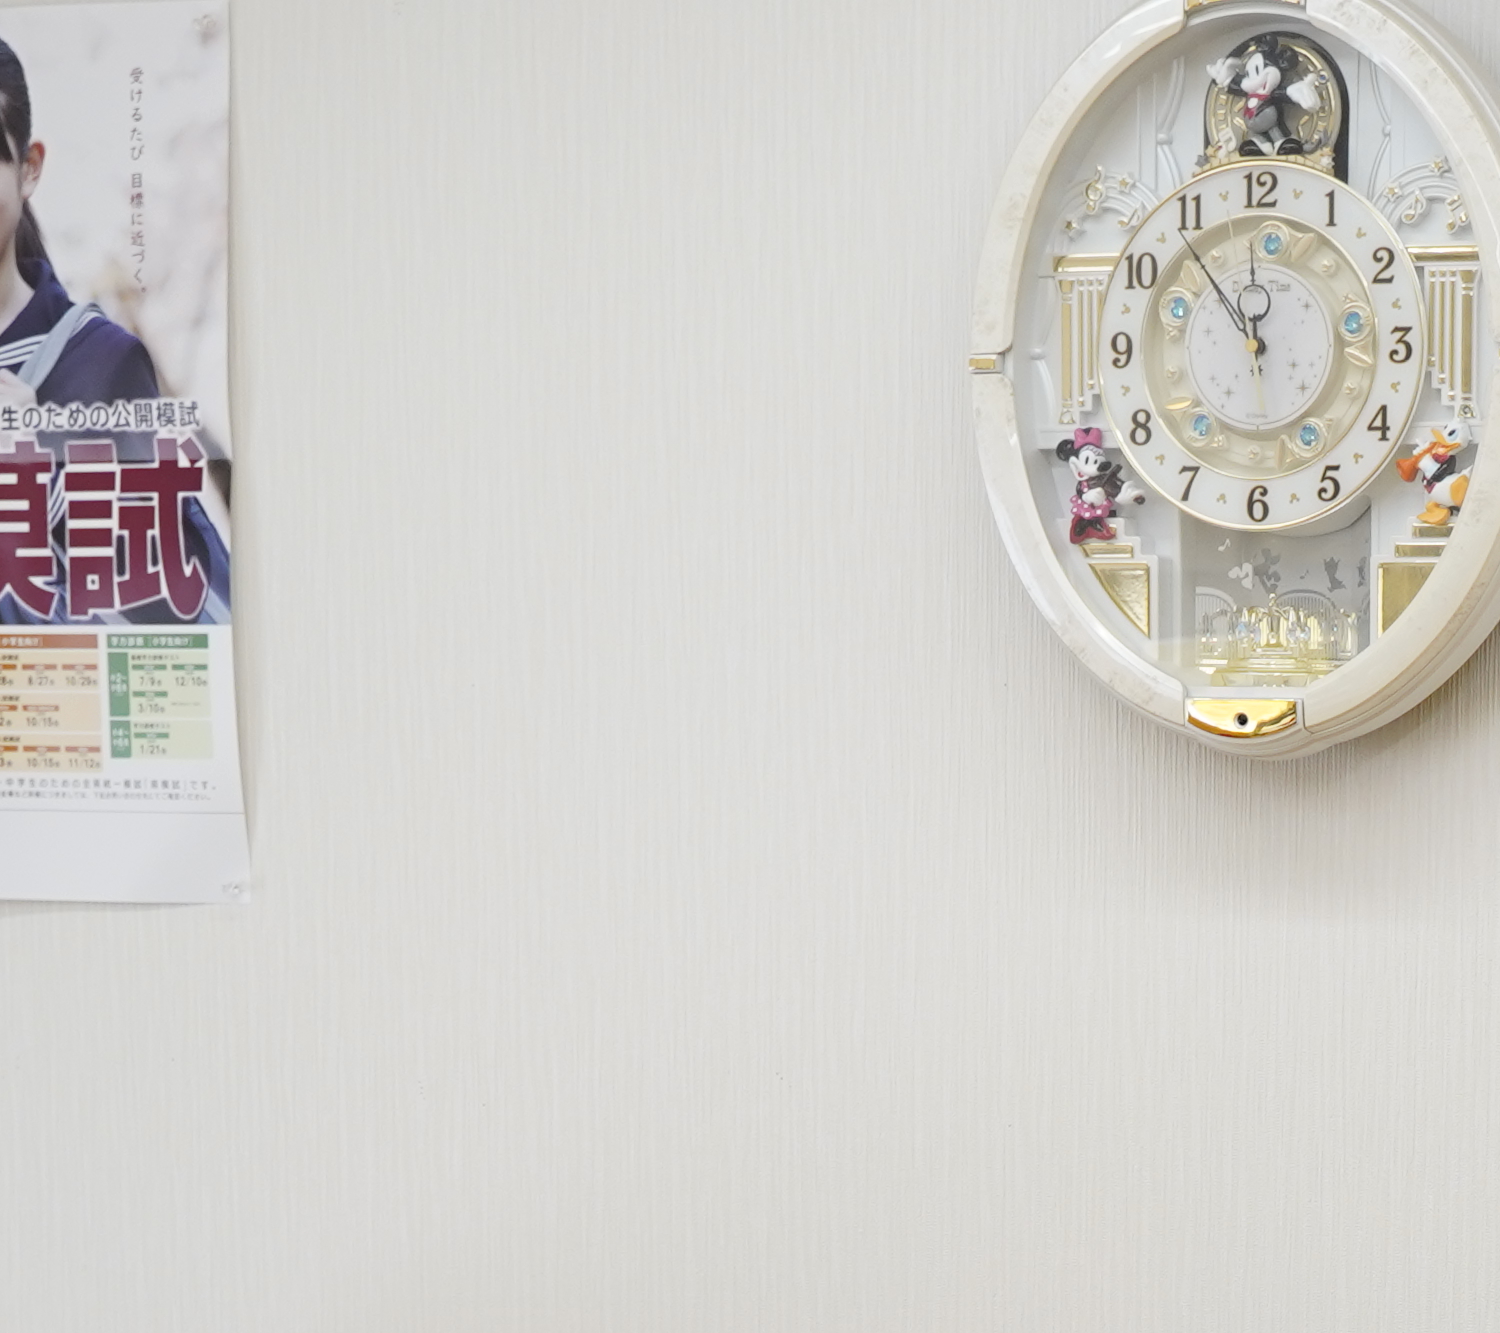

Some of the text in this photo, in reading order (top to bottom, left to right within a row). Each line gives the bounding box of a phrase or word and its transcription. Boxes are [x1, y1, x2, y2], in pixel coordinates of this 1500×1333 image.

[130, 67, 147, 294] 受けるたび 目標に近づく。
[1243, 172, 1278, 208] 12
[1177, 193, 1203, 230] 11
[1325, 190, 1337, 227] 1
[1125, 253, 1158, 289] 10
[1372, 248, 1395, 284] 2
[1111, 333, 1133, 368] 9
[1389, 326, 1412, 363] 3
[1130, 409, 1152, 446] 8
[1368, 405, 1390, 441] 4
[1178, 466, 1200, 501] 7
[1318, 465, 1340, 502] 5
[1247, 486, 1269, 522] 6
